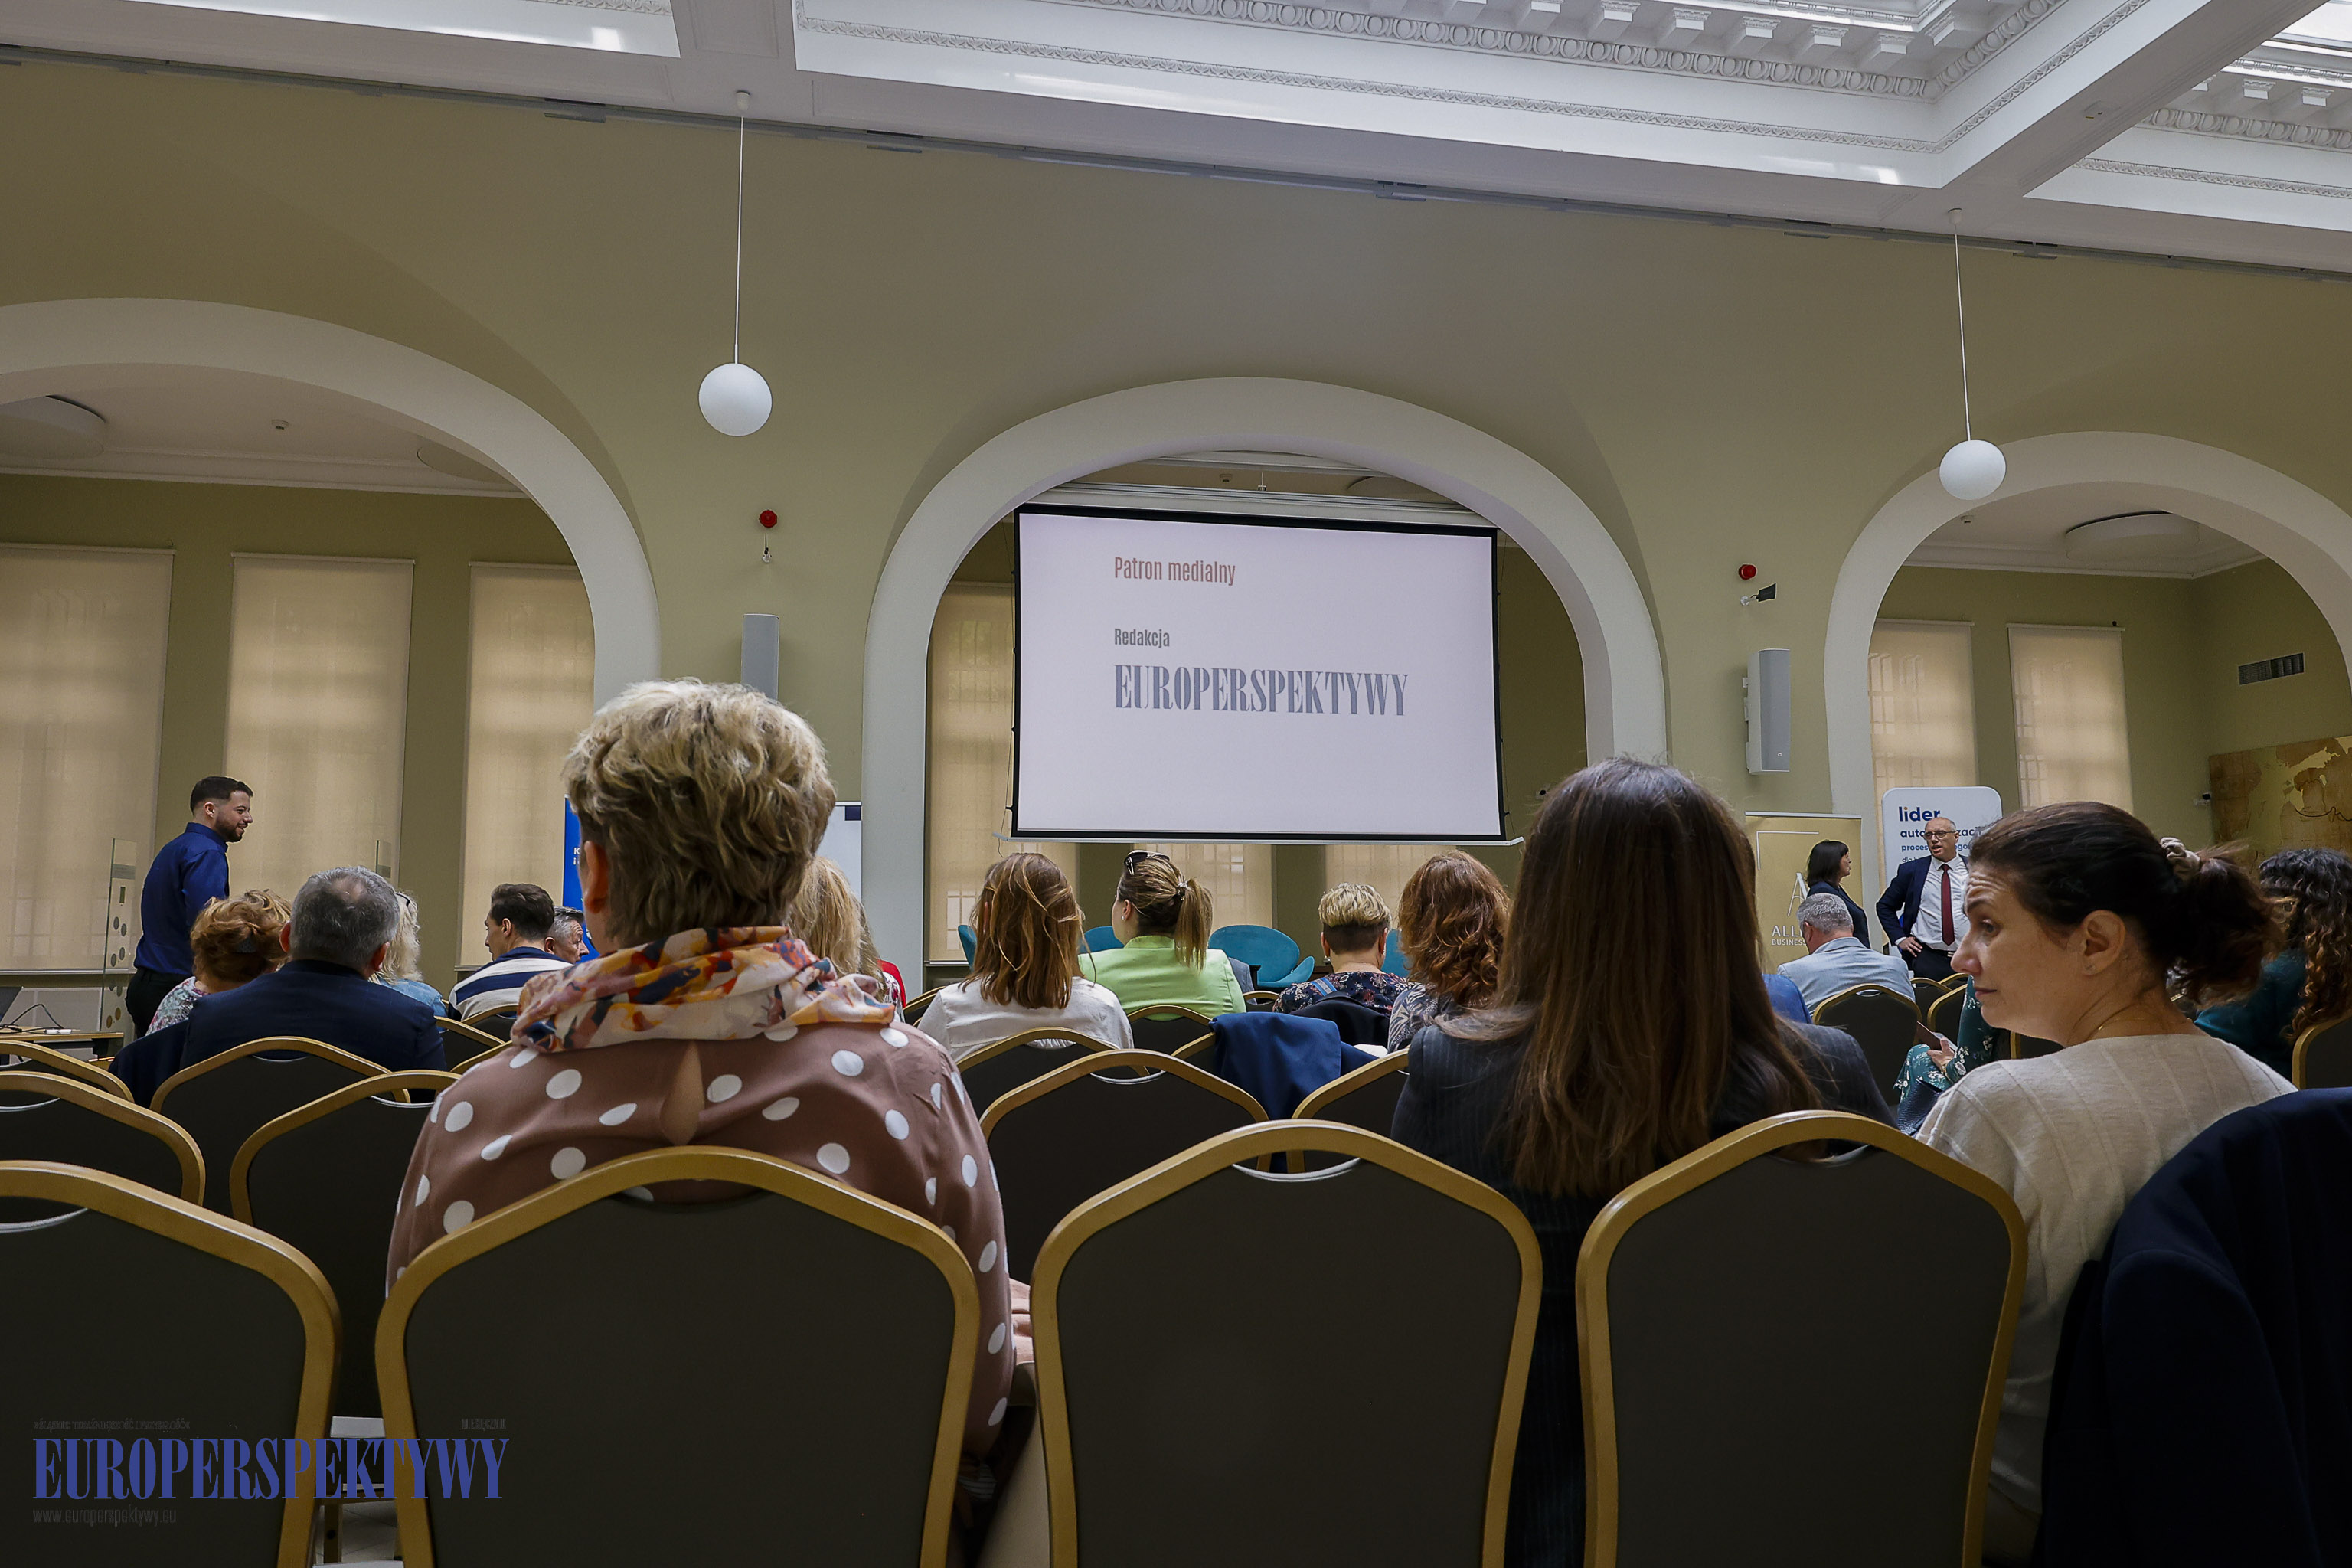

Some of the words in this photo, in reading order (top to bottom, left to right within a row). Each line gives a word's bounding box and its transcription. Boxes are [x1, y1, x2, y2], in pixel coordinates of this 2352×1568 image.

[1115, 557, 1162, 580] Patron
[1168, 560, 1236, 586] medialny
[1115, 628, 1170, 648] Redakcja
[1114, 665, 1408, 716] EUROPERSPEKTYWY
[1899, 806, 1940, 822] lider
